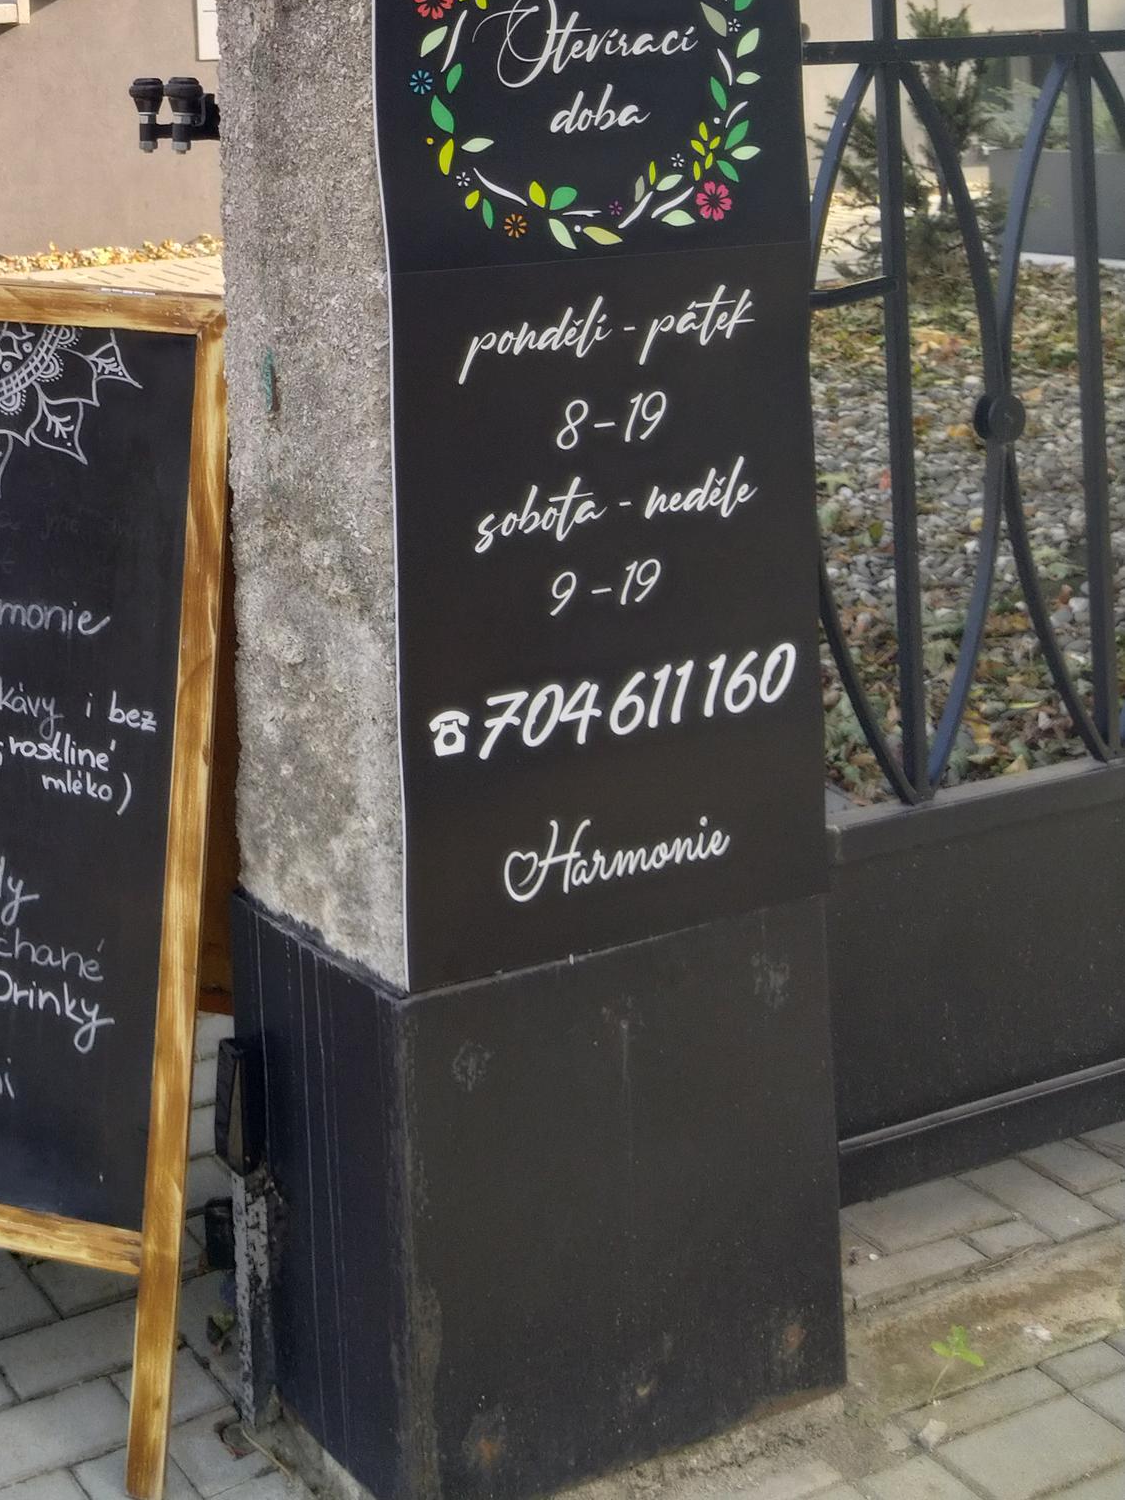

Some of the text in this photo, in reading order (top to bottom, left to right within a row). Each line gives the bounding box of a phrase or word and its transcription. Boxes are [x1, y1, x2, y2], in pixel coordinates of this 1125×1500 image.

[550, 83, 650, 135] doba
[458, 296, 613, 385] pondělí
[638, 284, 755, 365] pátek
[474, 476, 608, 553] sobota
[644, 456, 758, 518] neděle
[85, 692, 94, 719] i
[108, 690, 158, 733] bez
[503, 815, 731, 902] Harmonie
